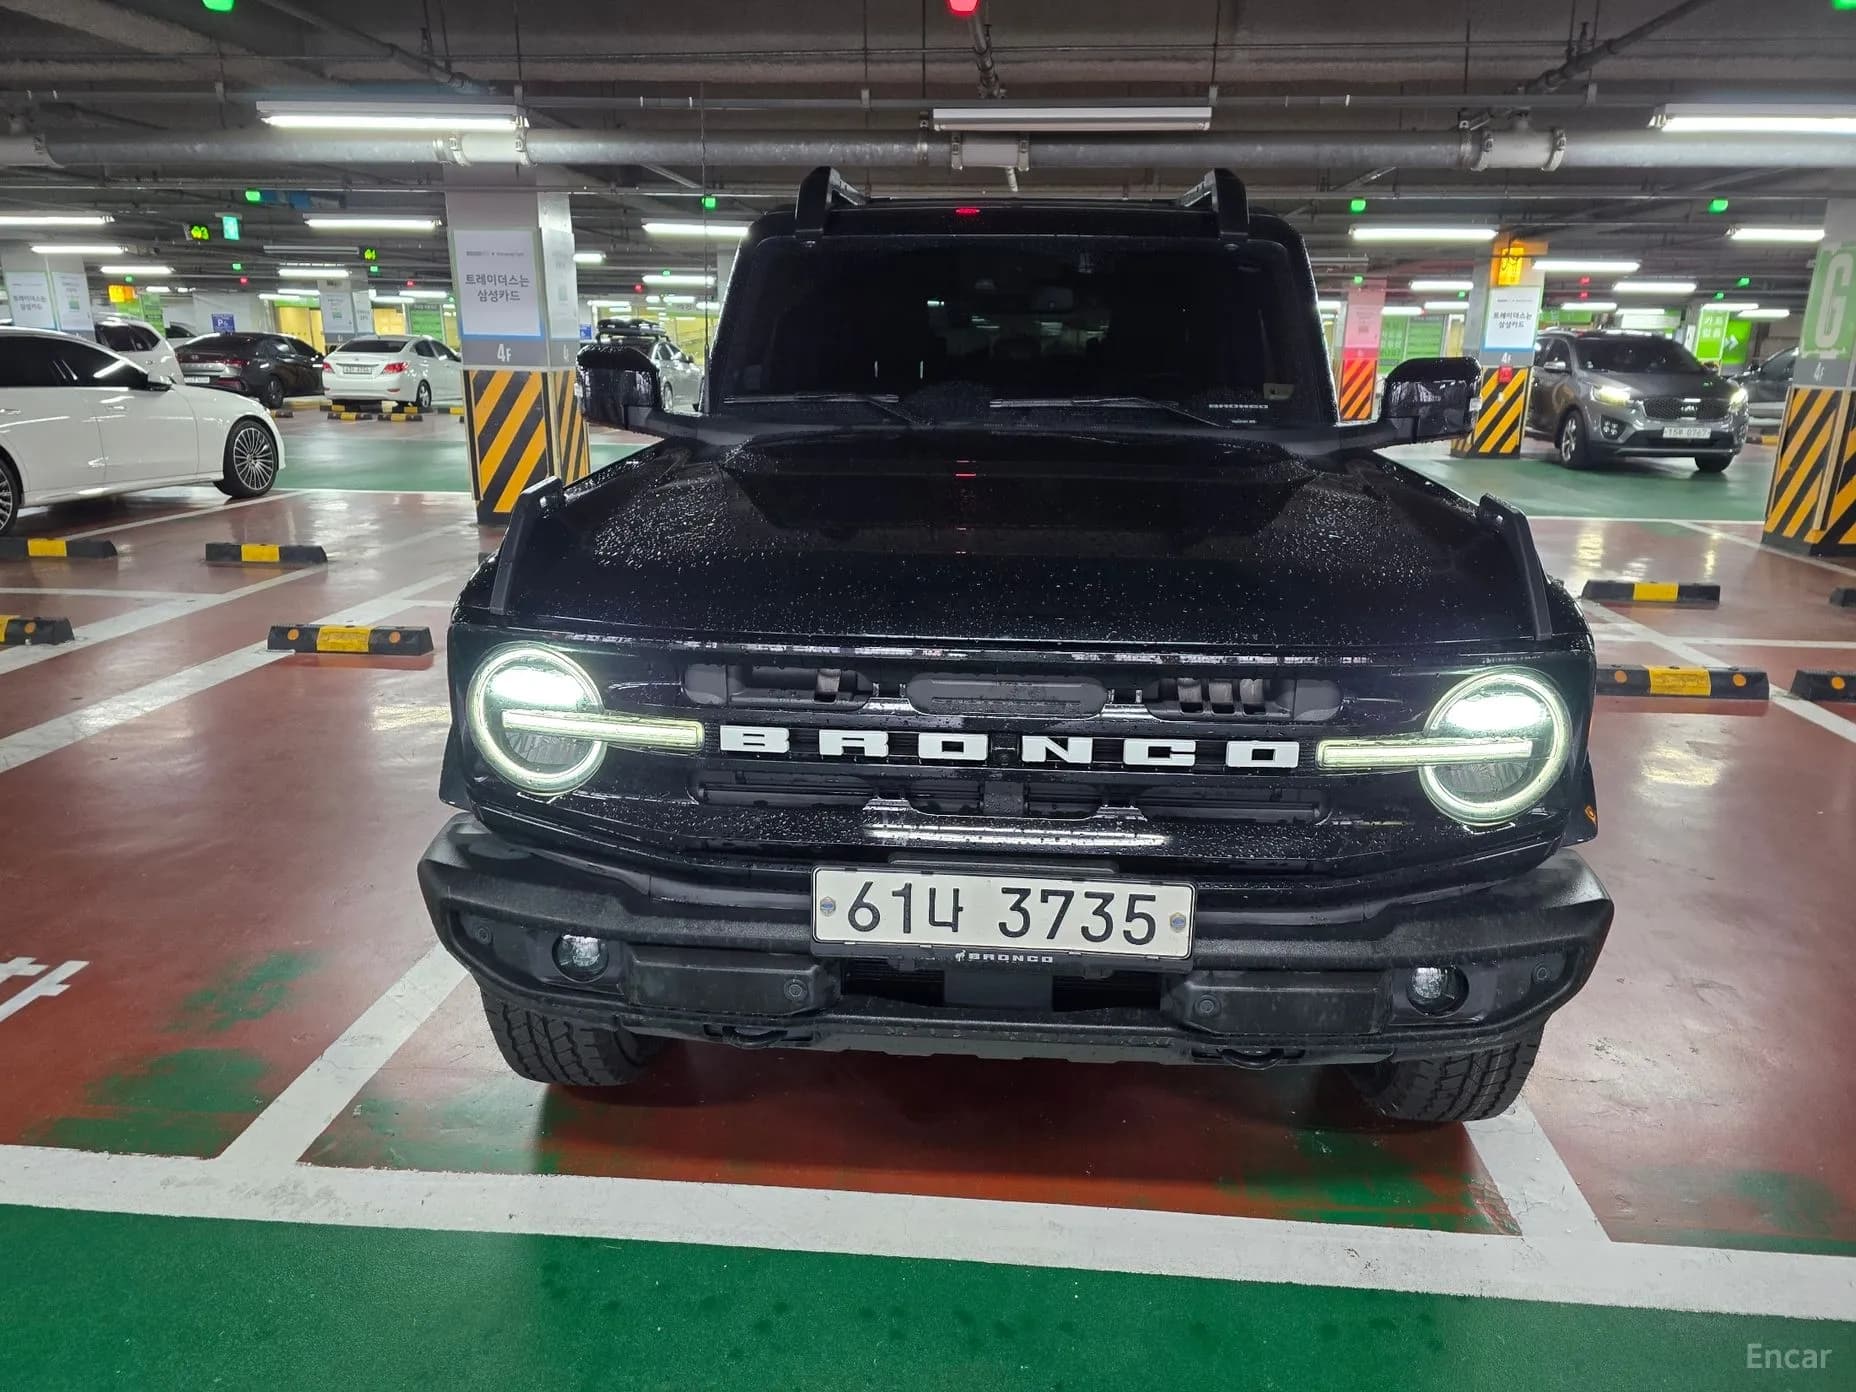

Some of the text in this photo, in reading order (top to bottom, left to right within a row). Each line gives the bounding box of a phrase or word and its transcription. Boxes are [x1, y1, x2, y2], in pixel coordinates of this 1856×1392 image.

[465, 274, 530, 288] 트레이더스는
[477, 289, 521, 303] 삼성카드
[1815, 253, 1854, 348] G
[496, 343, 512, 362] 4F
[719, 725, 1300, 769] BRONCO
[847, 880, 1157, 946] 61나 3735
[968, 952, 1054, 964] BRONCO
